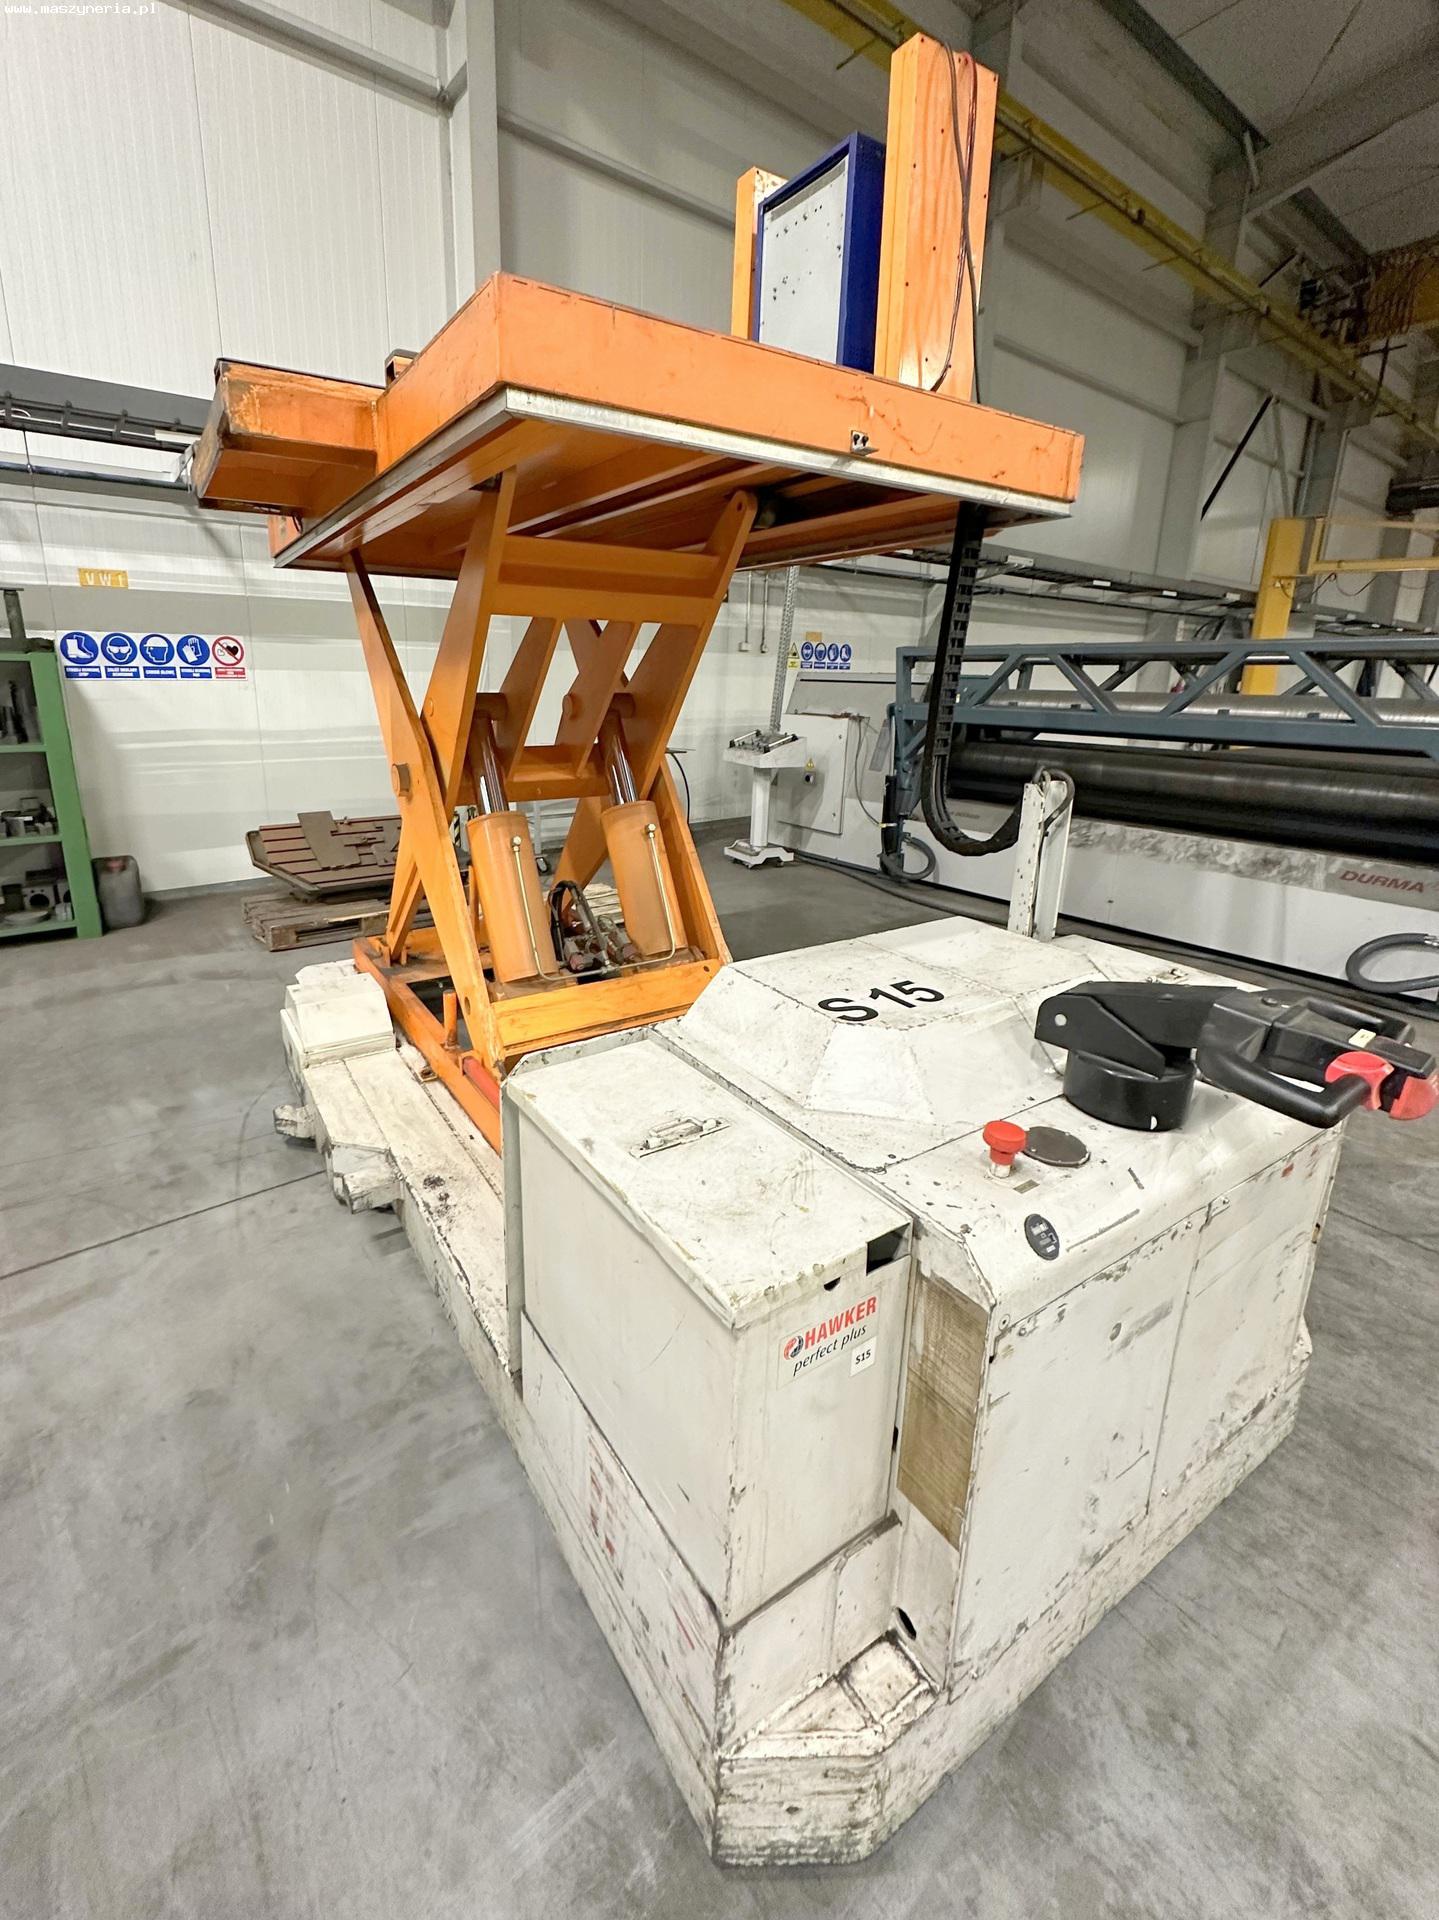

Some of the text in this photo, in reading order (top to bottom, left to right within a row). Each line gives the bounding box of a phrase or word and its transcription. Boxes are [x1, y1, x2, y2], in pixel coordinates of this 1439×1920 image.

[1339, 870, 1425, 893] DURMA
[804, 1296, 877, 1349] HAWKER
[793, 1324, 867, 1377] perfect plus
[855, 1348, 872, 1365] S15
